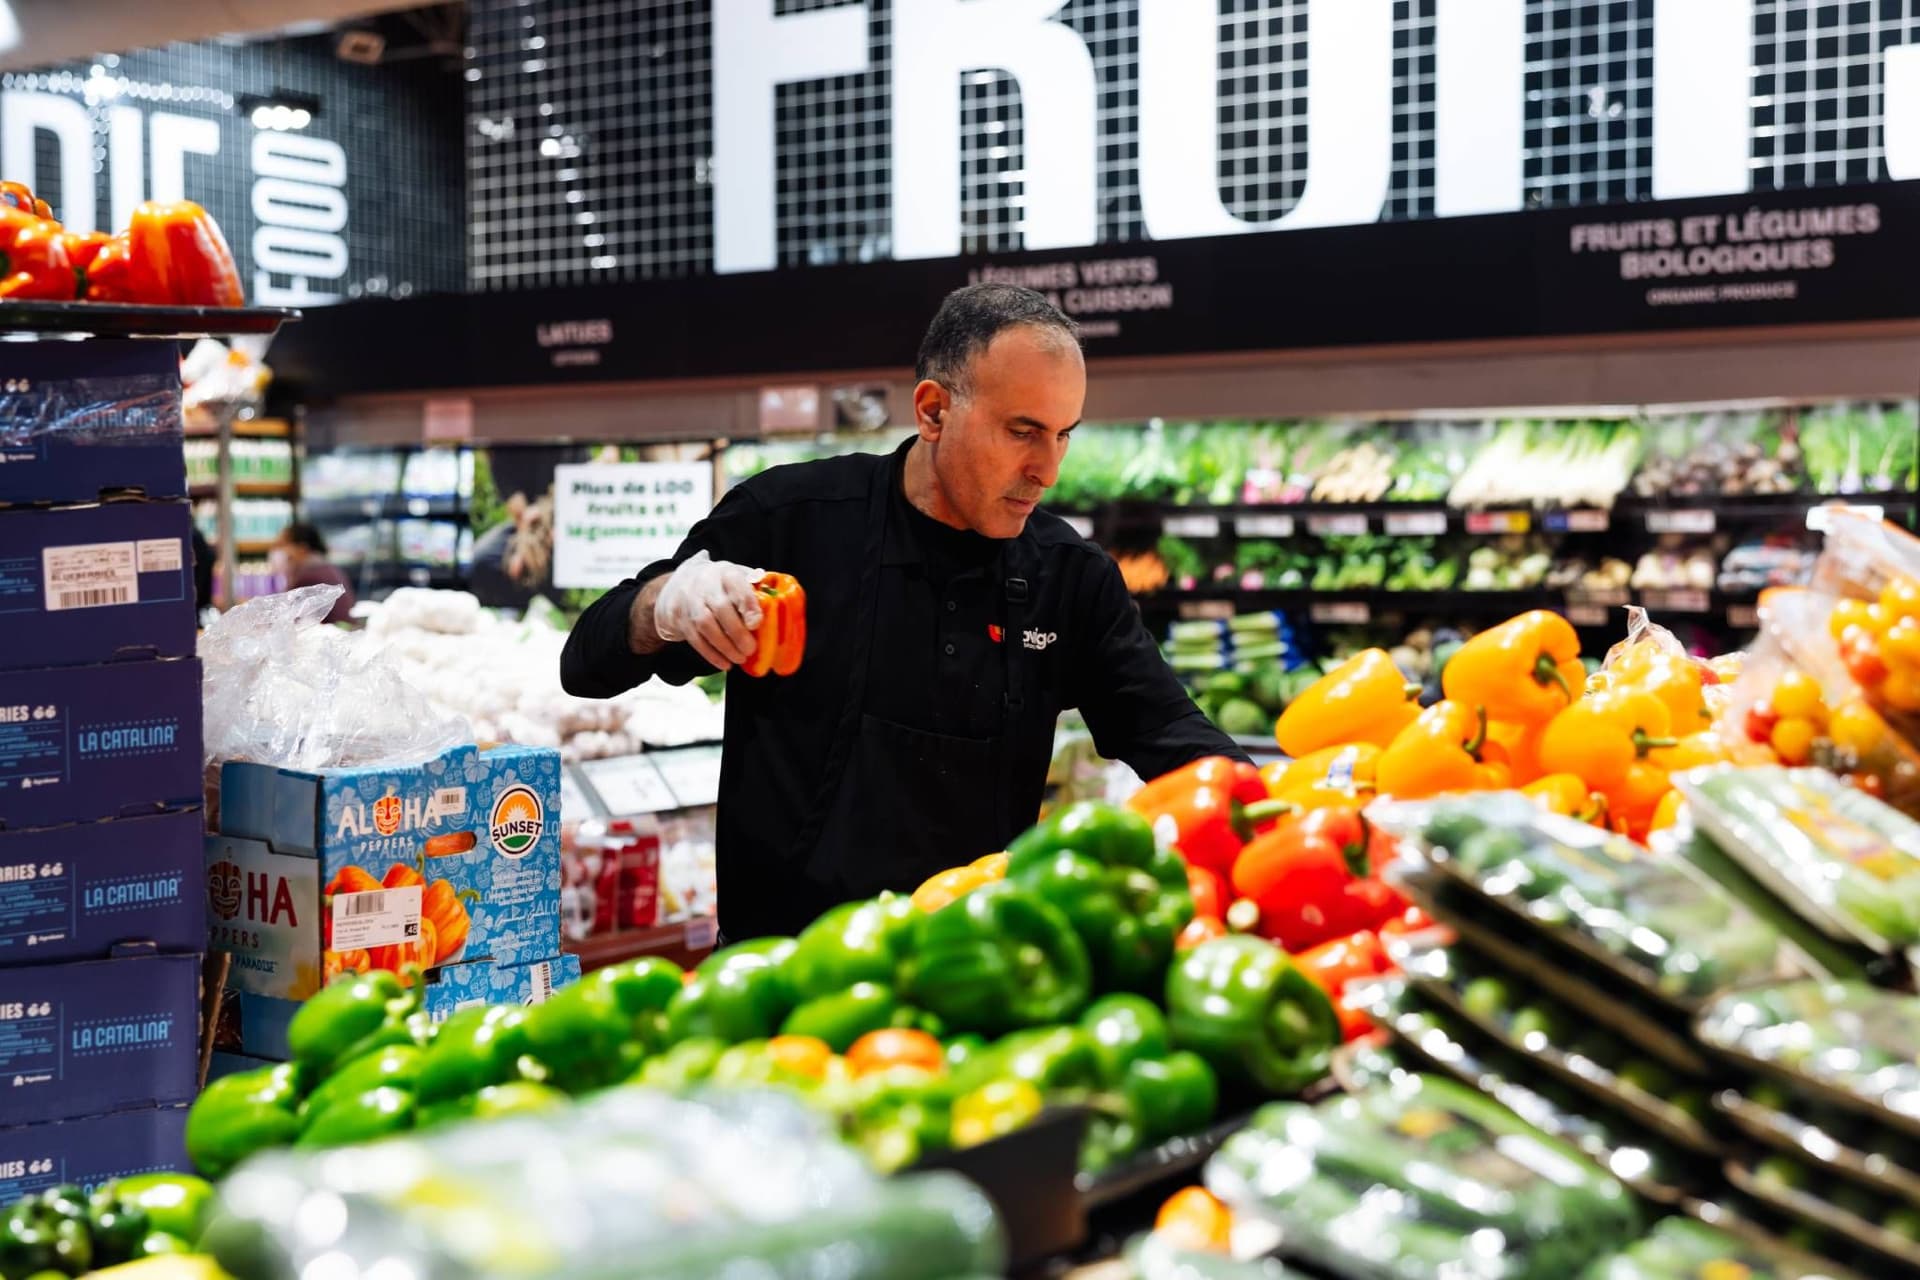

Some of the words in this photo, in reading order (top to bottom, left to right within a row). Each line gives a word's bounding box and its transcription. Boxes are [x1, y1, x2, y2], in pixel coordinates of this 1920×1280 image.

[250, 130, 348, 308] FOOD
[1570, 219, 1677, 252] FRUITS
[1681, 215, 1720, 244] ET
[1726, 203, 1880, 242] LÉGUMES
[1080, 256, 1158, 284] VERTS
[1620, 238, 1834, 280] BIOLOGIQUES
[79, 732, 98, 752] LA
[492, 820, 542, 842] SUNSET
[85, 887, 103, 908] LA
[73, 1029, 92, 1050] LA
